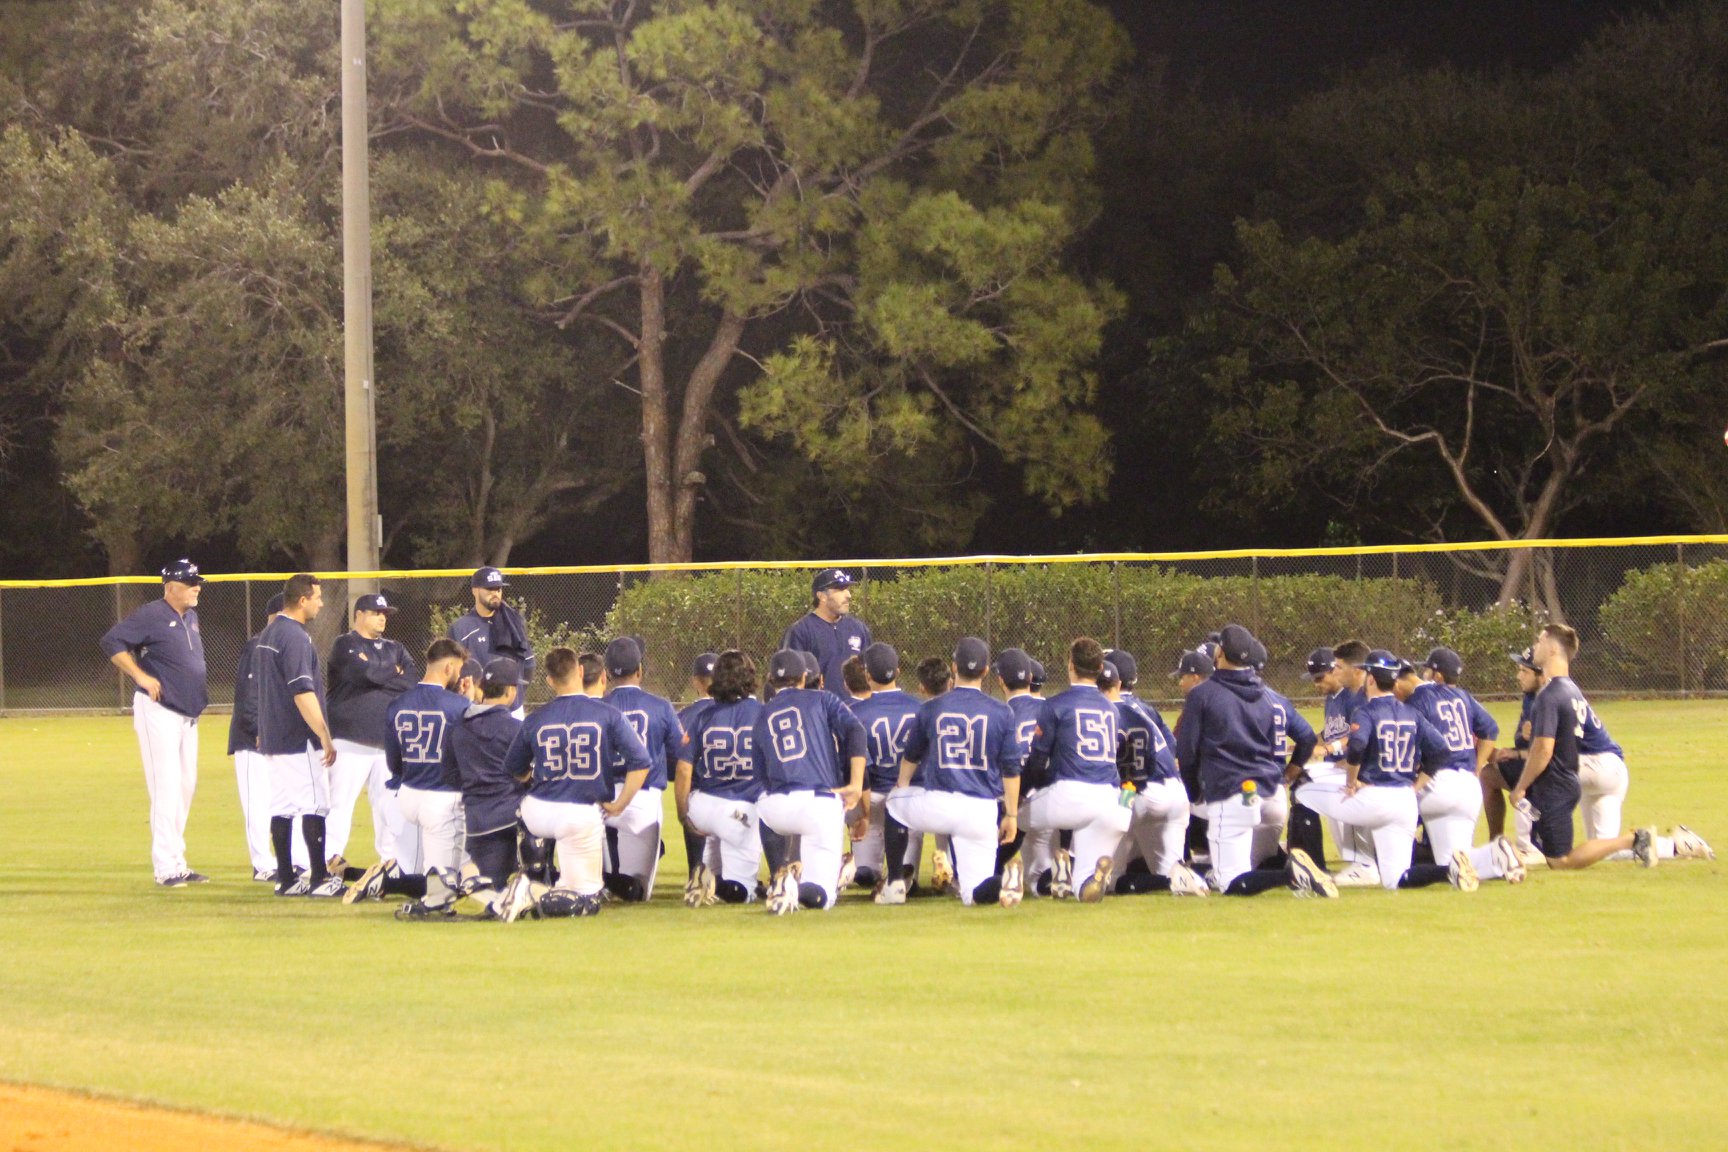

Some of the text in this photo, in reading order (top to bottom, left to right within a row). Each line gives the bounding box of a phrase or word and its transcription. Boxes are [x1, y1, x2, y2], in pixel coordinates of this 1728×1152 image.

[395, 709, 446, 763] 27
[536, 722, 602, 781] 33
[768, 706, 807, 763] 8
[936, 712, 988, 771] 21
[1075, 709, 1116, 764] 51
[1377, 720, 1417, 772] 37
[1437, 698, 1475, 752] 31
